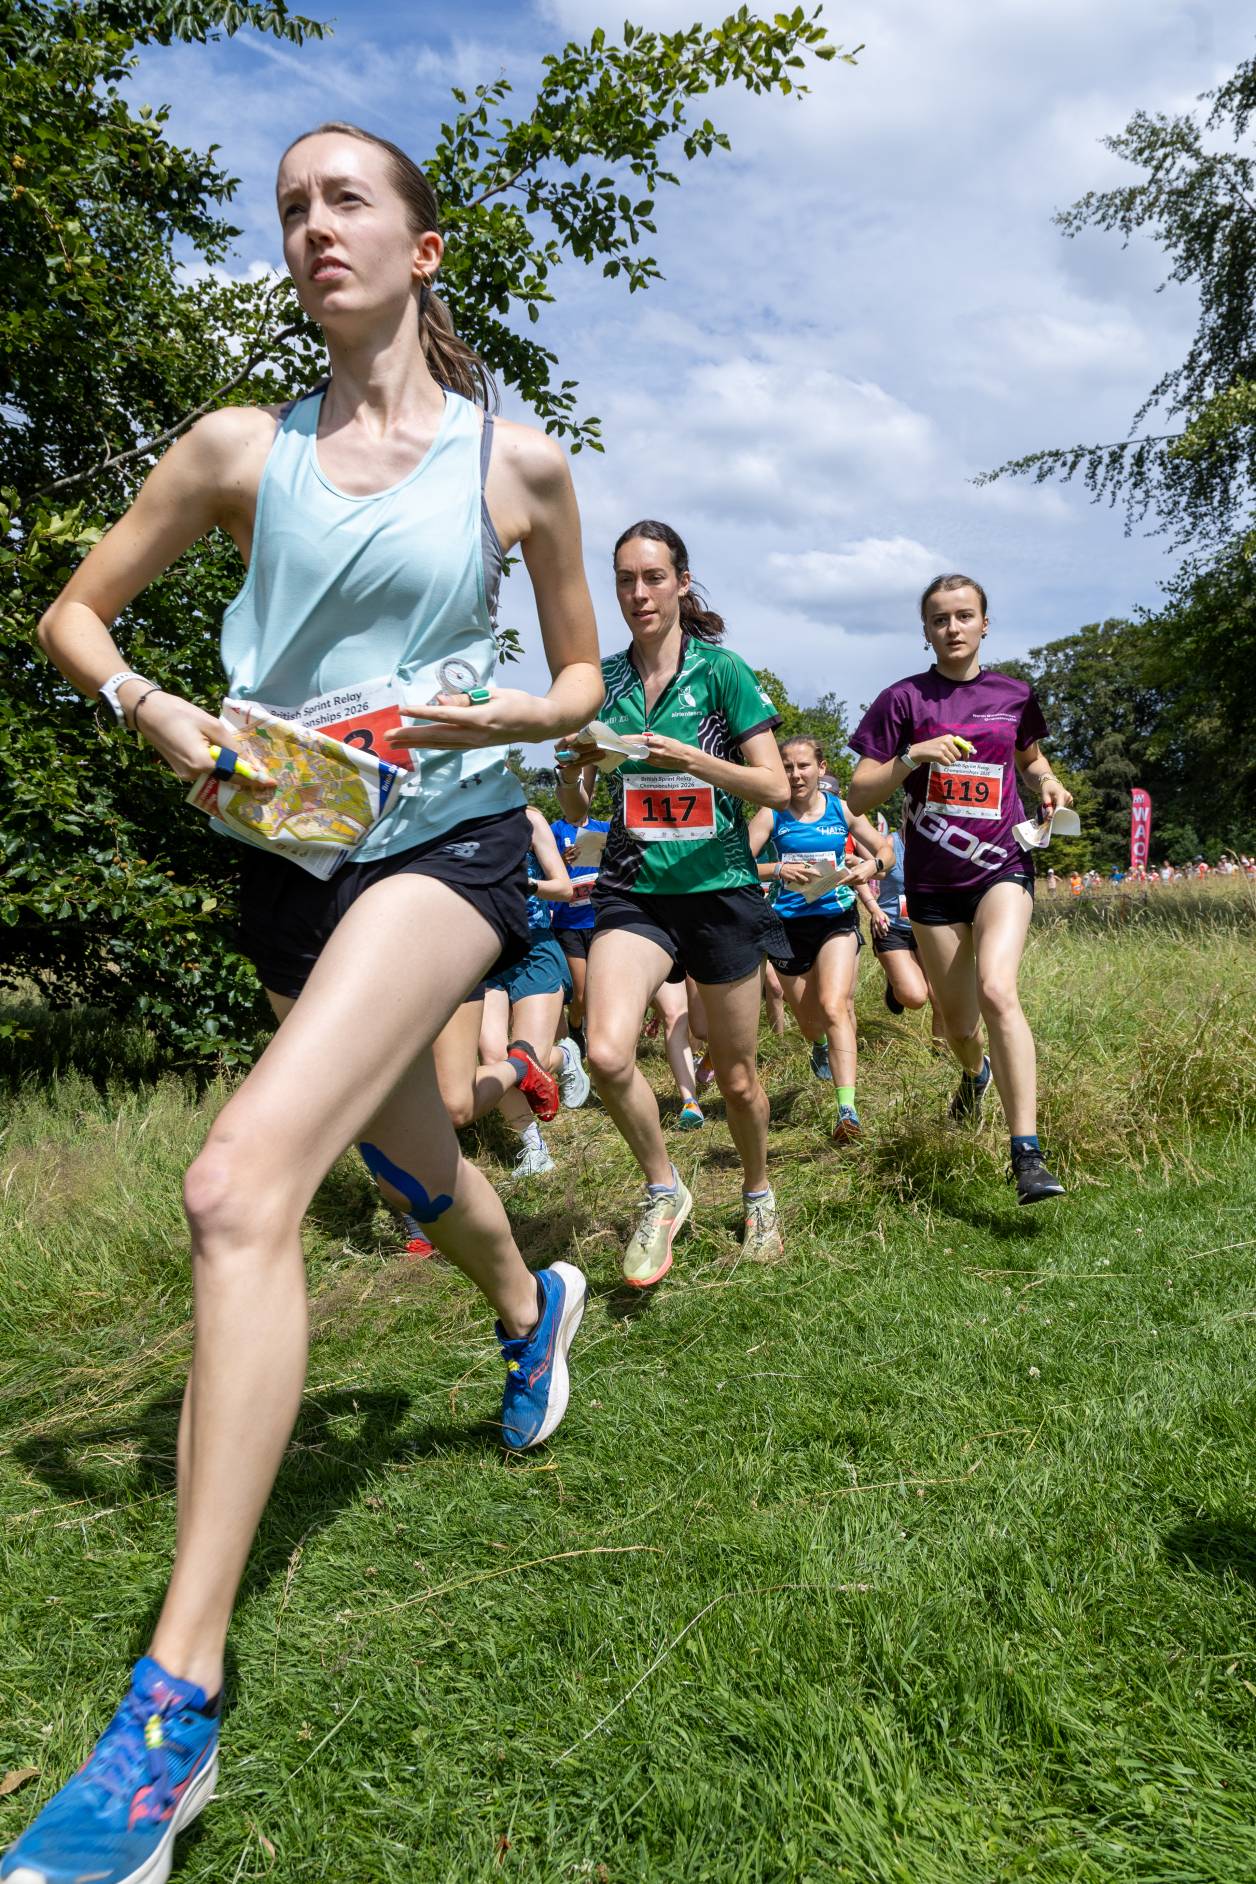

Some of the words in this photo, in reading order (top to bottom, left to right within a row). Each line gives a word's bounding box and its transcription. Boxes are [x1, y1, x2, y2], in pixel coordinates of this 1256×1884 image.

[302, 710, 342, 728] ionships
[345, 702, 369, 716] 2026
[303, 699, 332, 717] Sprint
[334, 691, 362, 706] Relay
[942, 779, 990, 803] 119
[642, 796, 697, 822] 117
